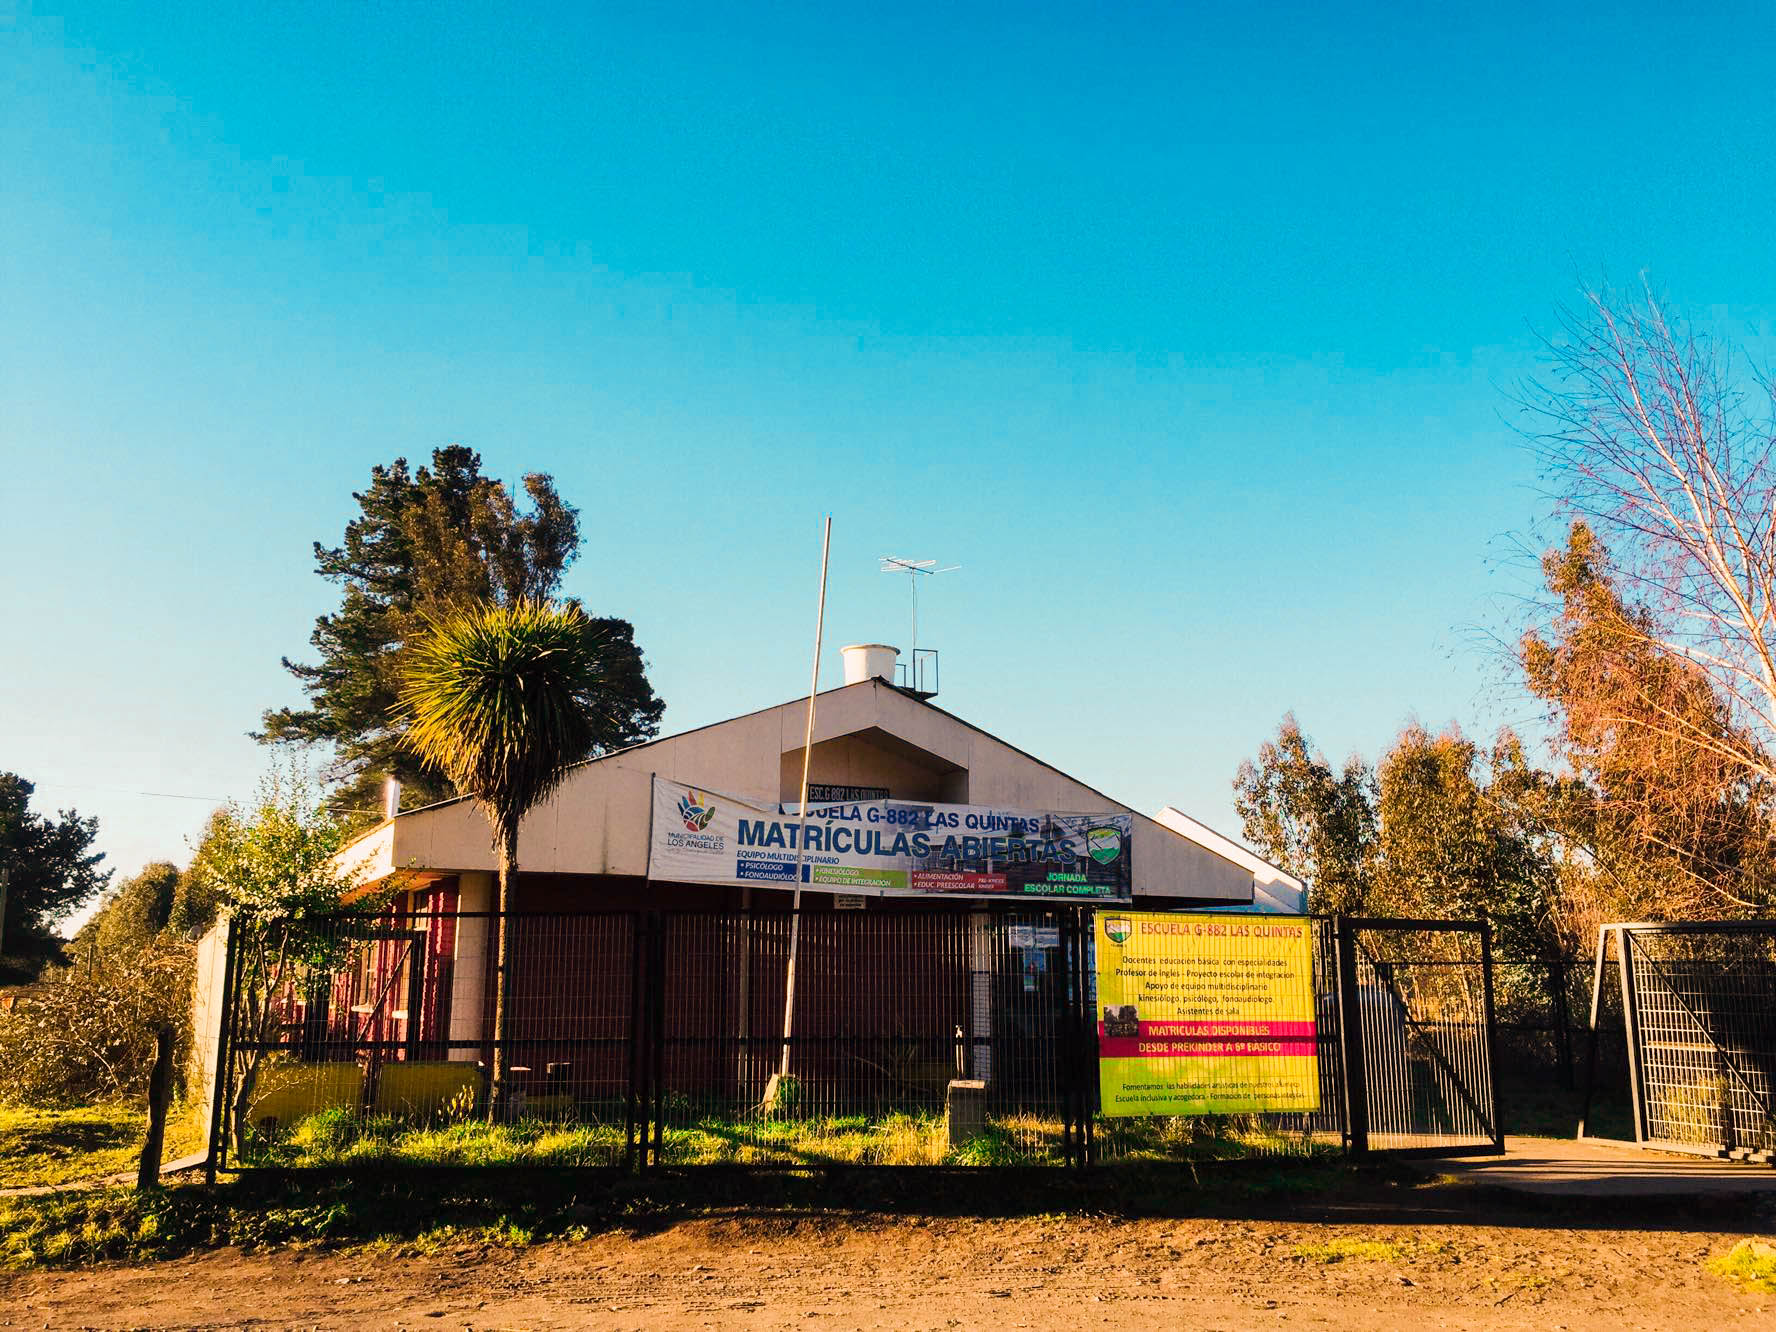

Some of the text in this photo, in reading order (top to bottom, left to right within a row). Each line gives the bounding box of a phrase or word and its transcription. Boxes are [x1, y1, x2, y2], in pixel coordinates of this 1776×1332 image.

[831, 787, 844, 800] 882
[867, 807, 918, 825] G-882
[965, 814, 1039, 833] QUINTAS
[667, 838, 724, 850] LOS ANGELES
[737, 818, 1077, 865] MATRÍCULAS ABIERTAS
[737, 850, 766, 859] EQUIPO
[1047, 872, 1087, 882] JORNADA
[936, 882, 975, 890] PREESCOLAR
[1024, 883, 1111, 895] ESCOLAR COMPLETA
[1141, 922, 1303, 938] ESCUELA G-882 LAS QUINTAS
[1122, 956, 1156, 965] Docentes
[1115, 968, 1146, 977] Profesor
[1149, 969, 1157, 977] de
[1186, 970, 1217, 979] Proyecto
[1220, 970, 1243, 978] escolar
[1145, 981, 1168, 991] Apoyo
[1171, 982, 1179, 990] de
[1181, 983, 1206, 991] equipo
[1177, 1007, 1213, 1015] Asistentes
[1215, 1007, 1224, 1015] de
[1211, 1025, 1270, 1037] DISPONIBLES
[1139, 1043, 1169, 1053] DESDE
[1171, 1042, 1224, 1053] PREKINDER
[1225, 1043, 1232, 1052] A
[1122, 1083, 1163, 1091] Fomentamos
[1140, 1094, 1167, 1102] inclusiva
